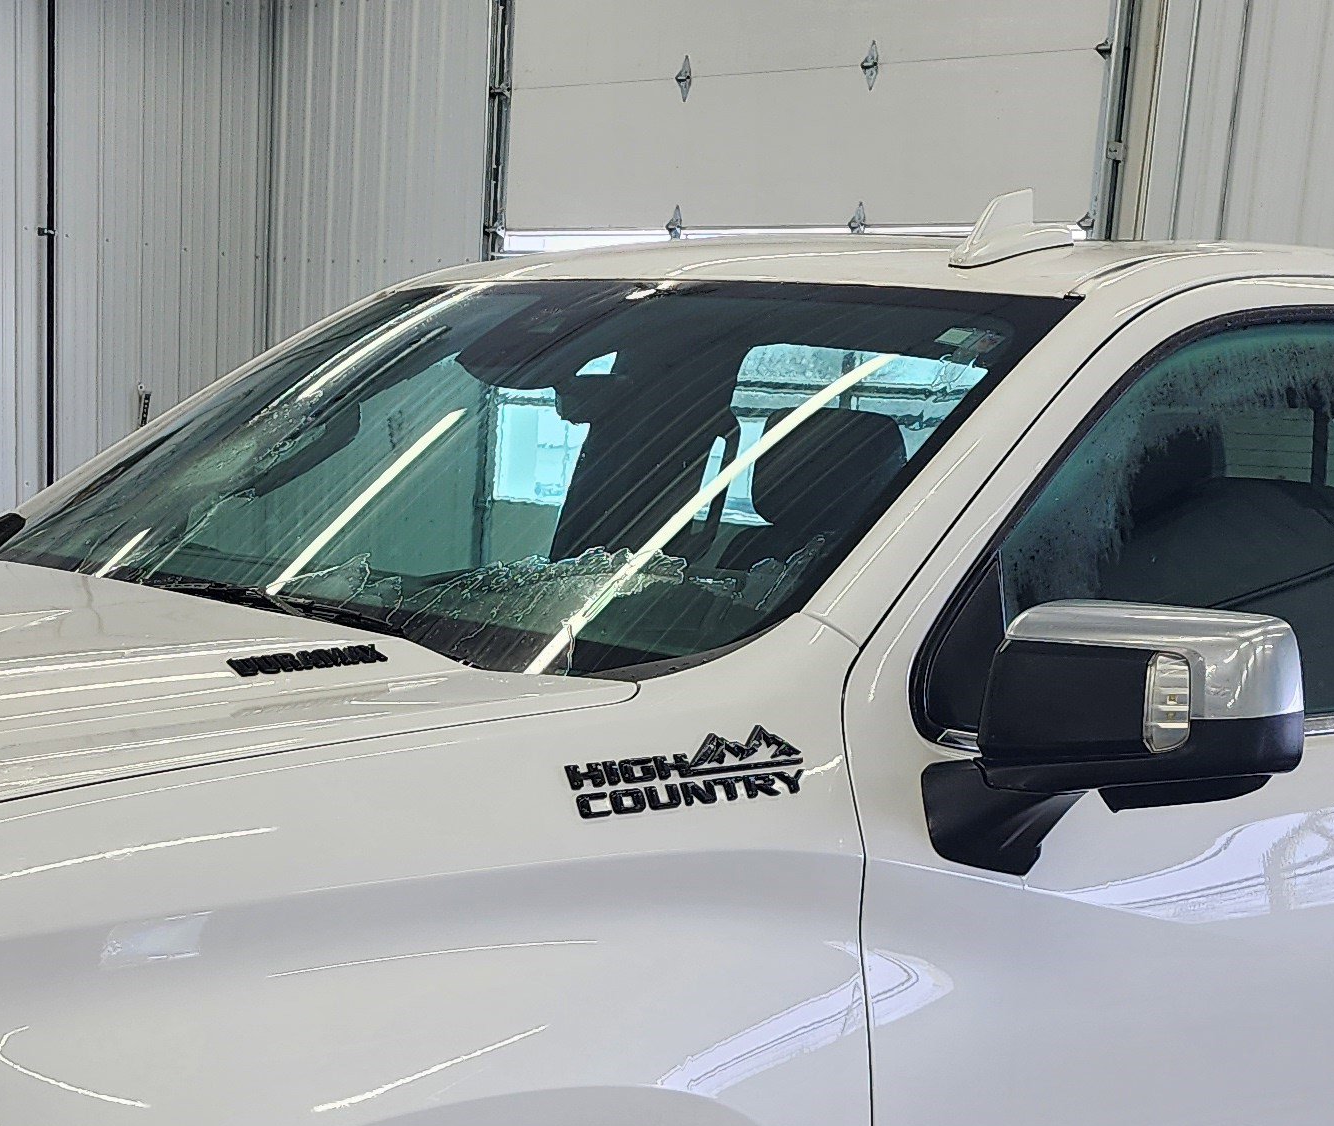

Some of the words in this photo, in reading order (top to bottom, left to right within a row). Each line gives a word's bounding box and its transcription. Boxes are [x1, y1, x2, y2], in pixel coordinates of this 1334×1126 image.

[226, 643, 389, 677] DURAMAX
[564, 752, 694, 791] HIGH
[575, 768, 805, 819] COUNTRY
